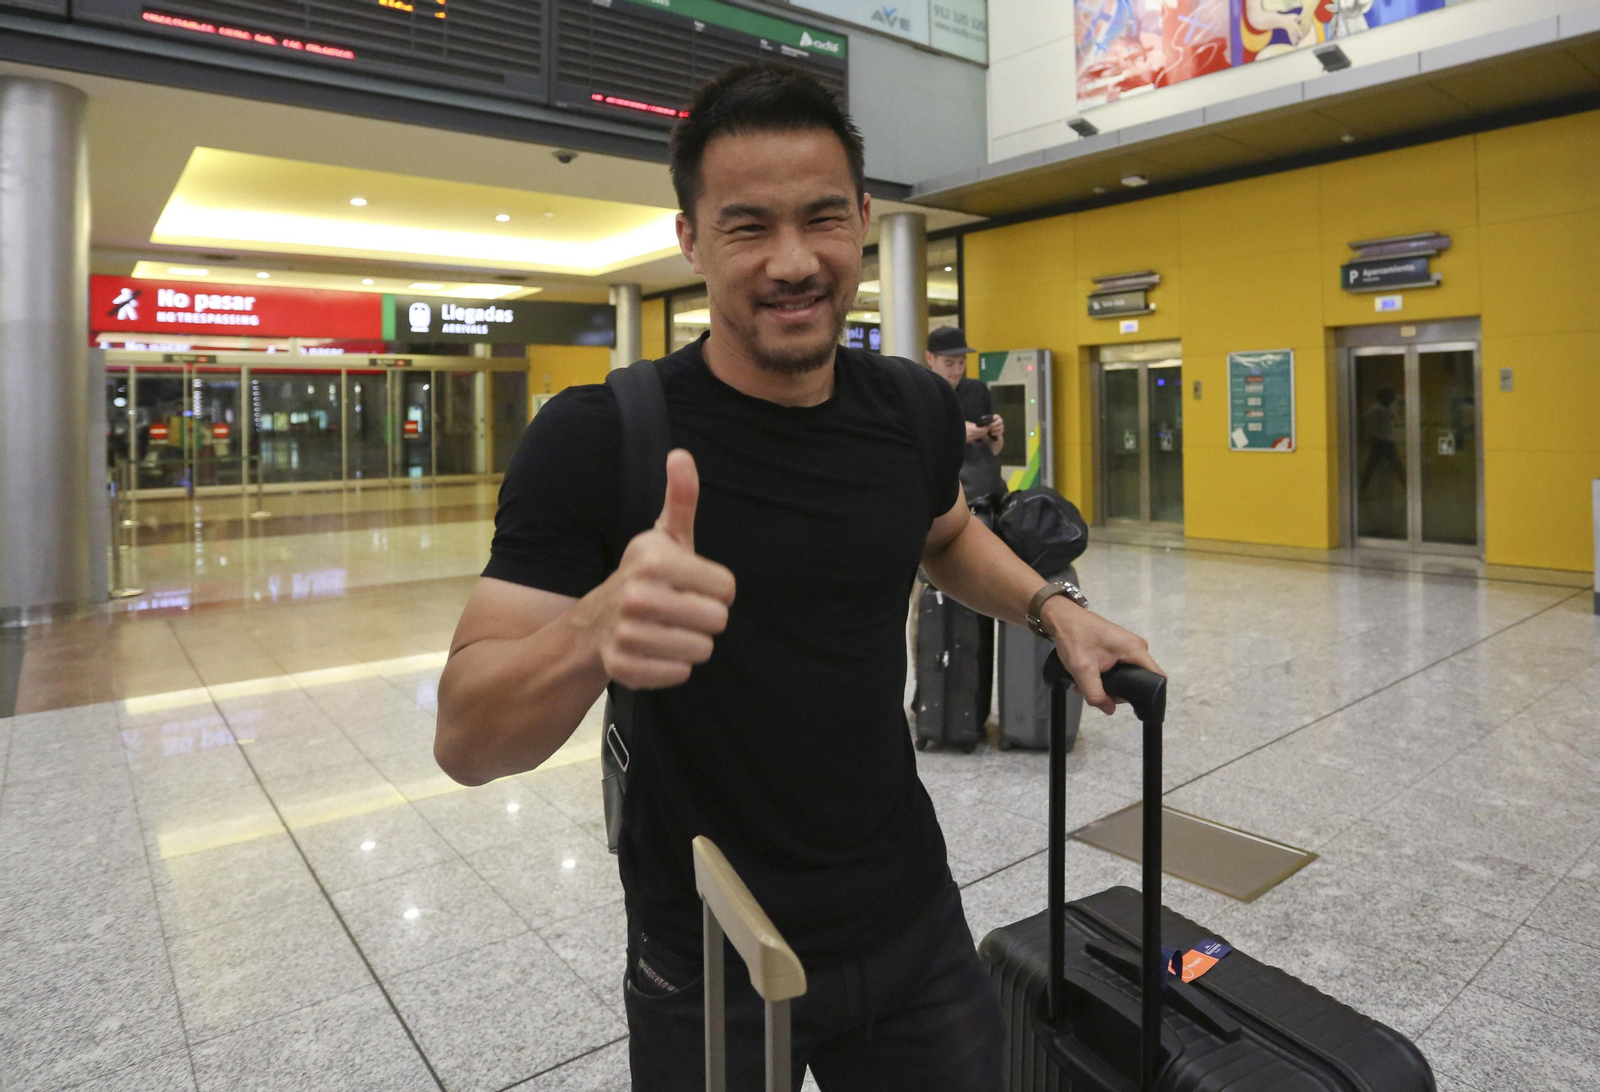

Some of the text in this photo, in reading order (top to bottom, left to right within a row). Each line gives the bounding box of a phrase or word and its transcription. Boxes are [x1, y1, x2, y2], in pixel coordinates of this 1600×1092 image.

[870, 7, 911, 32] AVE
[1349, 264, 1416, 284] P Aparcamiento
[157, 288, 256, 312] No pasar
[156, 311, 260, 326] NO TRESPASSING
[441, 303, 514, 324] Llegadas
[441, 323, 488, 335] ARRIVALS
